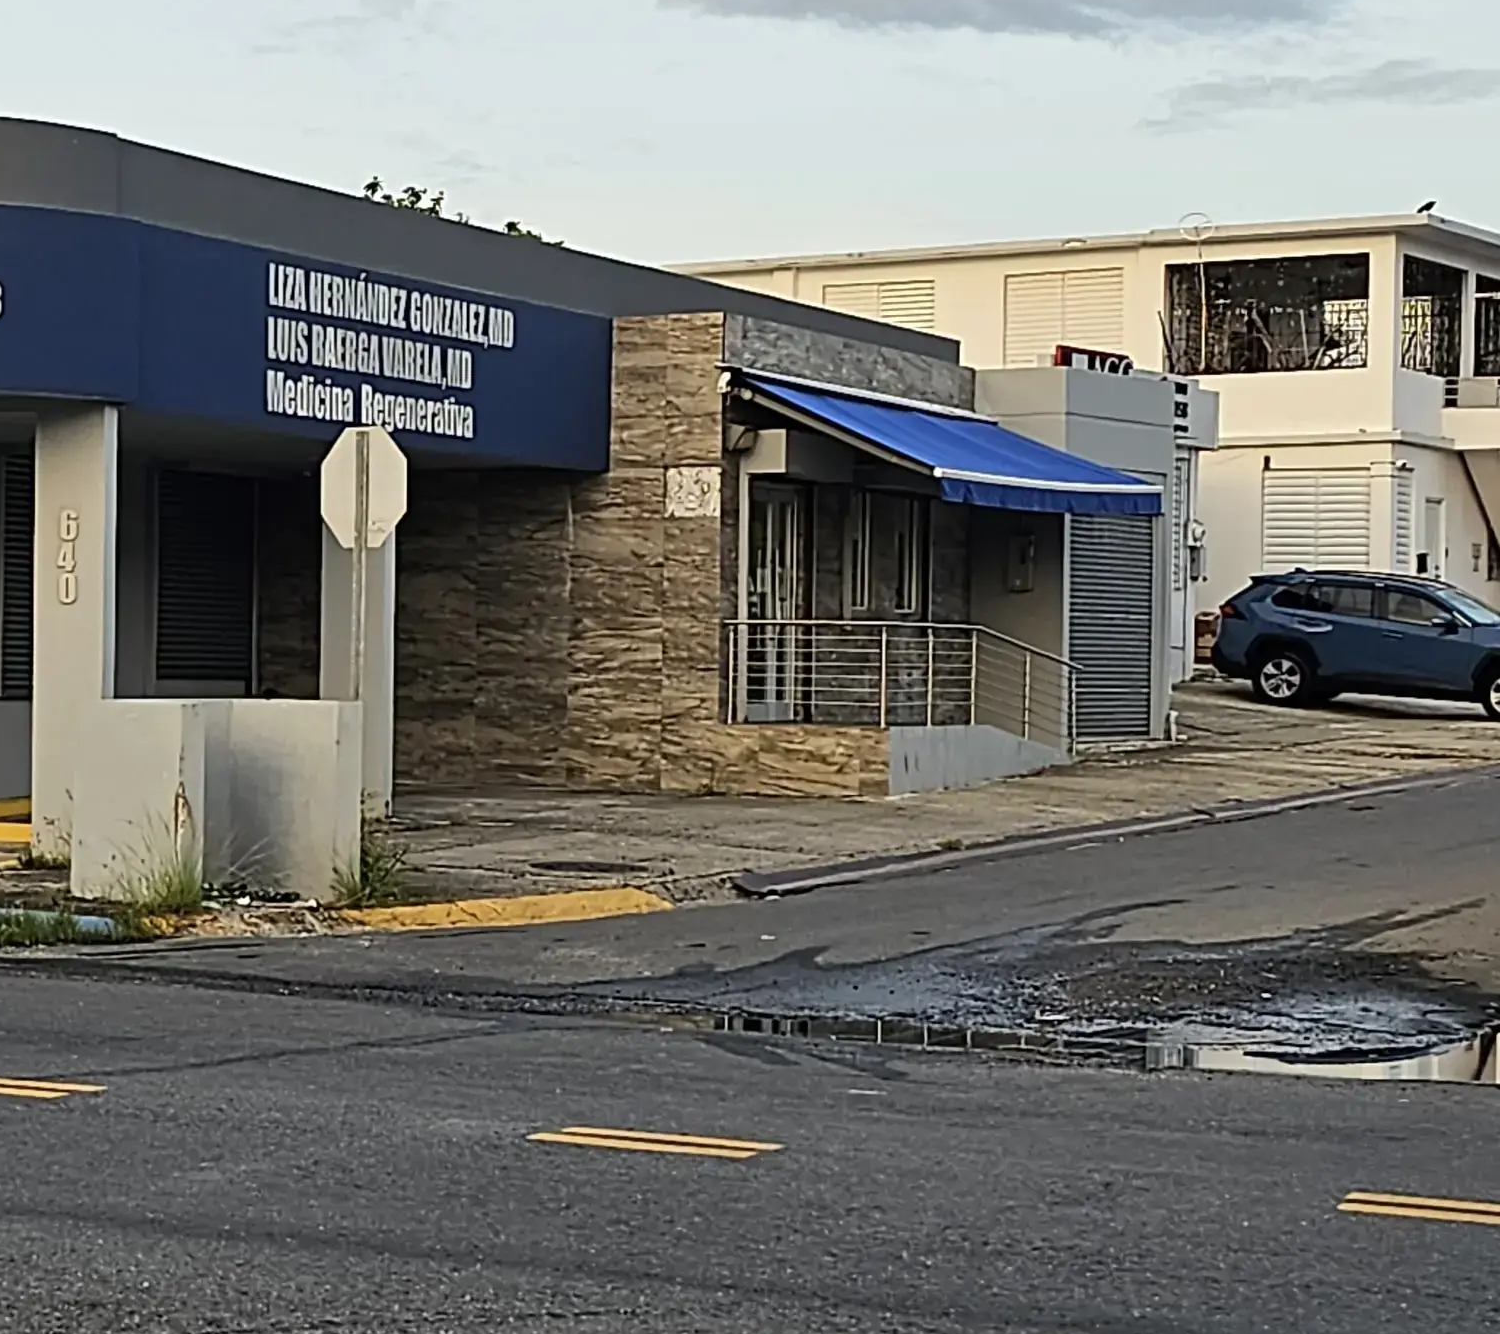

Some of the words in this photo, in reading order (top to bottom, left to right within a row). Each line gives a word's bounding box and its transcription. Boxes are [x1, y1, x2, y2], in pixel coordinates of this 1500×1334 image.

[268, 262, 306, 312] LIZA
[309, 272, 407, 329] HERNÁNDEZ
[267, 316, 308, 365] LUIS
[311, 324, 380, 376] BAERGA
[266, 369, 353, 422] Medicina
[361, 383, 474, 439] Regenerativa
[57, 509, 79, 605] 640
